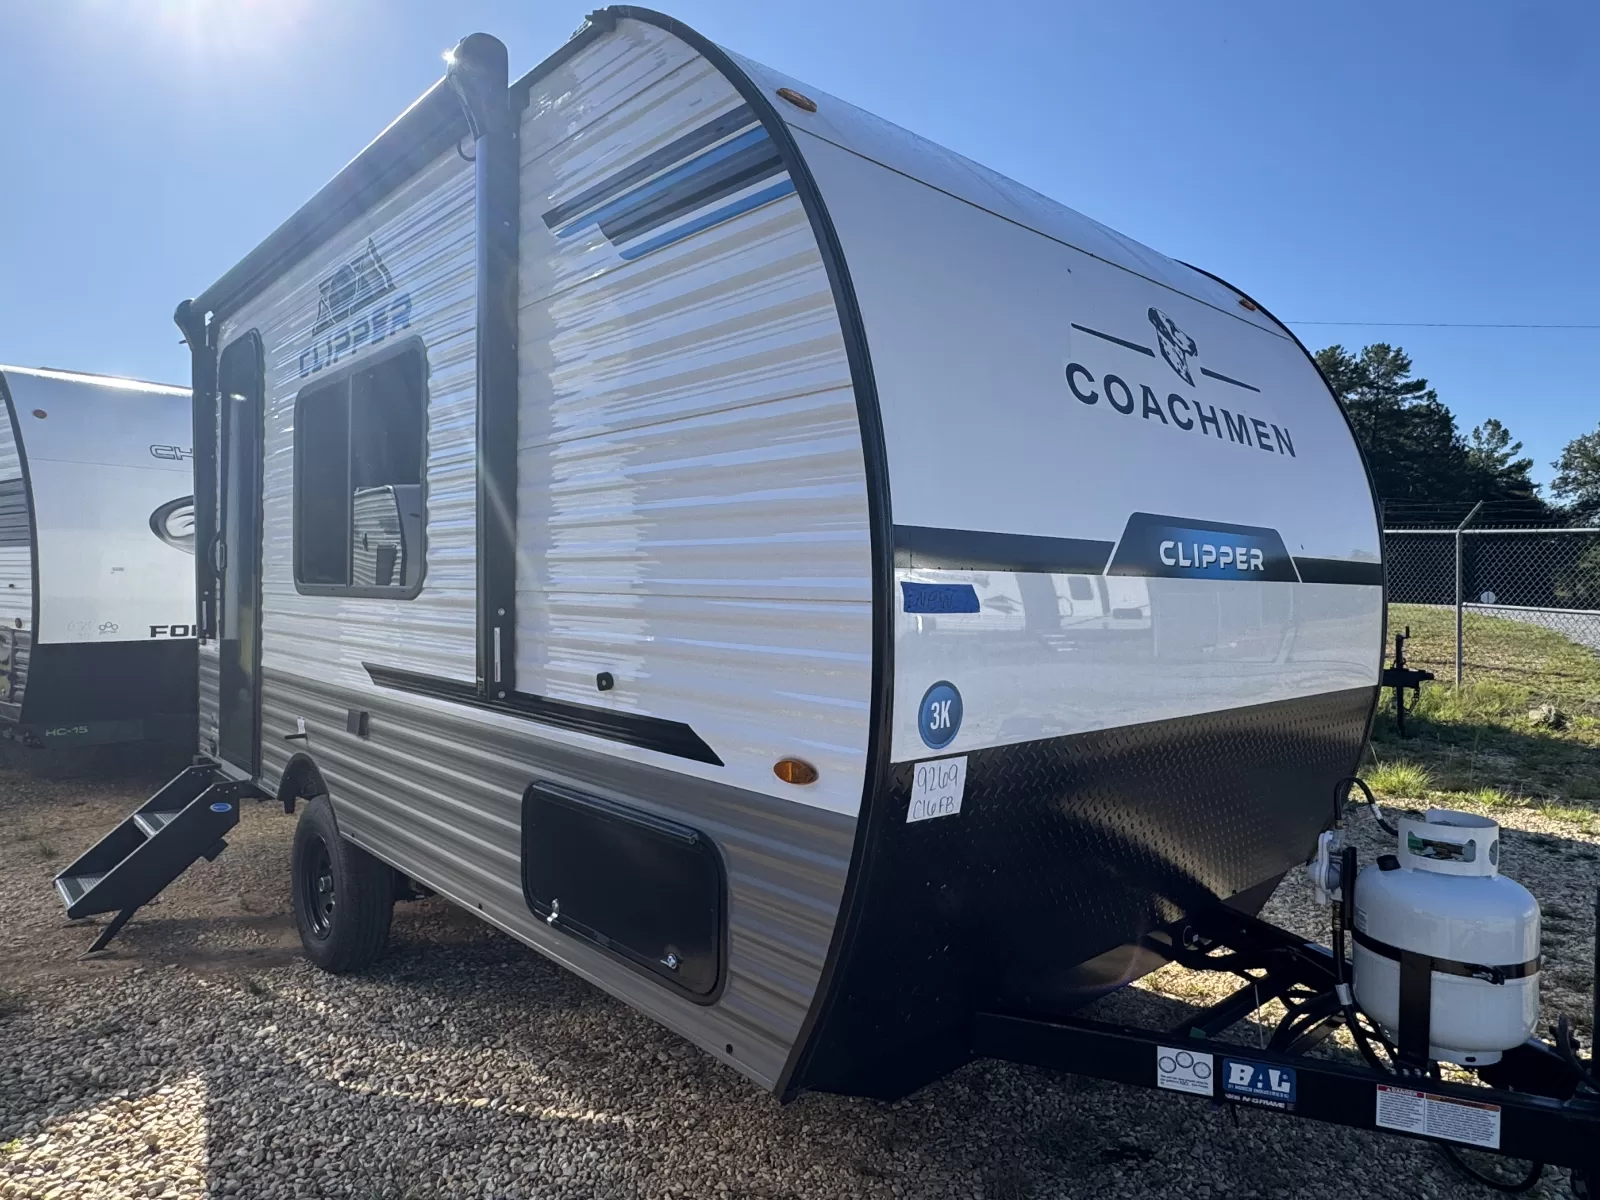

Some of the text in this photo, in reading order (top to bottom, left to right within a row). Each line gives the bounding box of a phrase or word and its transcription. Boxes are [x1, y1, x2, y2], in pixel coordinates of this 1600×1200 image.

[299, 292, 412, 378] CLIPPER
[1065, 362, 1296, 458] COACHMEN
[1159, 540, 1265, 572] CLIPPER
[930, 699, 951, 730] 3K
[45, 725, 88, 737] HC-15
[917, 763, 958, 794] 9269
[1228, 1062, 1291, 1093] BAL
